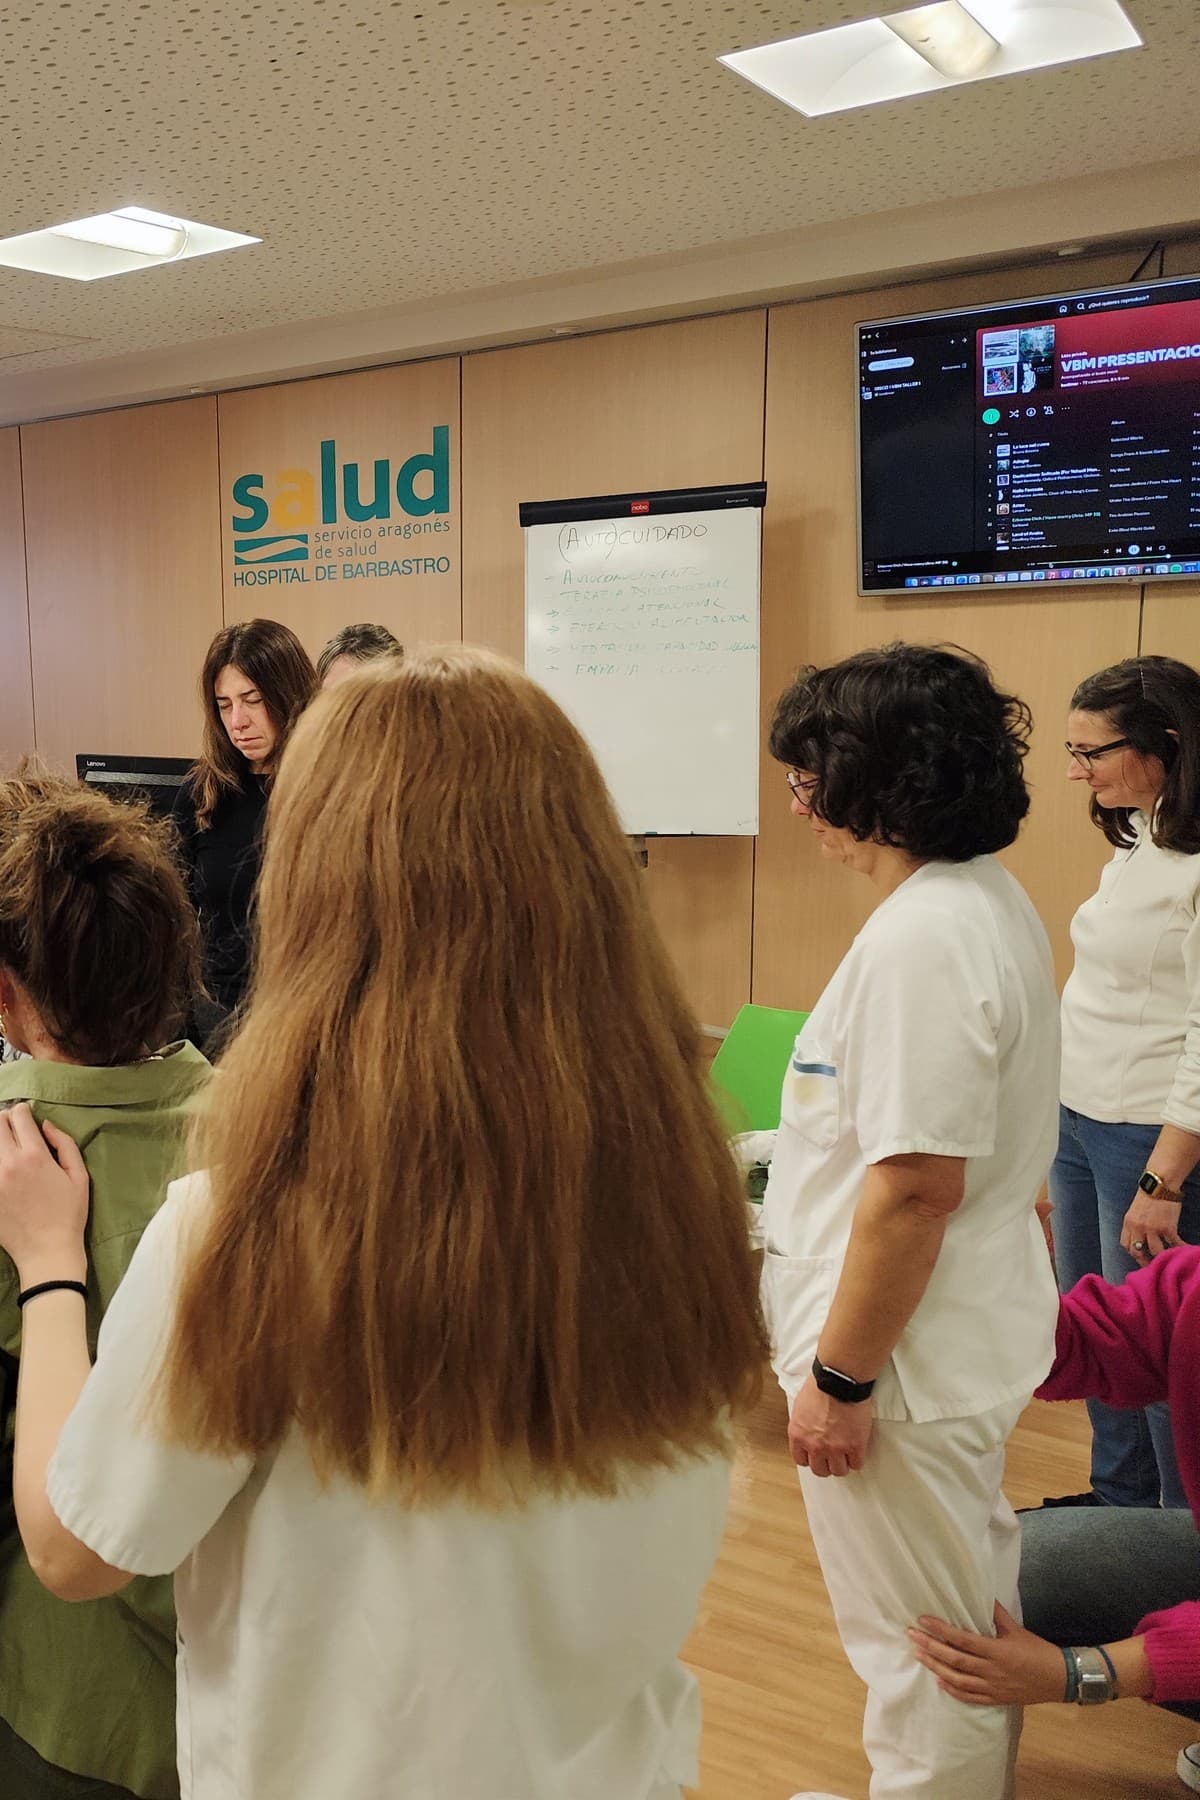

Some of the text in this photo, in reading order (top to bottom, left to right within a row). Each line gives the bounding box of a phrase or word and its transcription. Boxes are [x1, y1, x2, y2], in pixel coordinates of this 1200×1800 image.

[1061, 357, 1096, 372] VBM
[233, 424, 450, 533] salud
[313, 519, 450, 543] servicio aragonés
[558, 523, 708, 563] (AUTO)CUIDADO
[315, 541, 377, 560] de salud
[234, 556, 450, 587] HOSPITAL DE BARBASTRO
